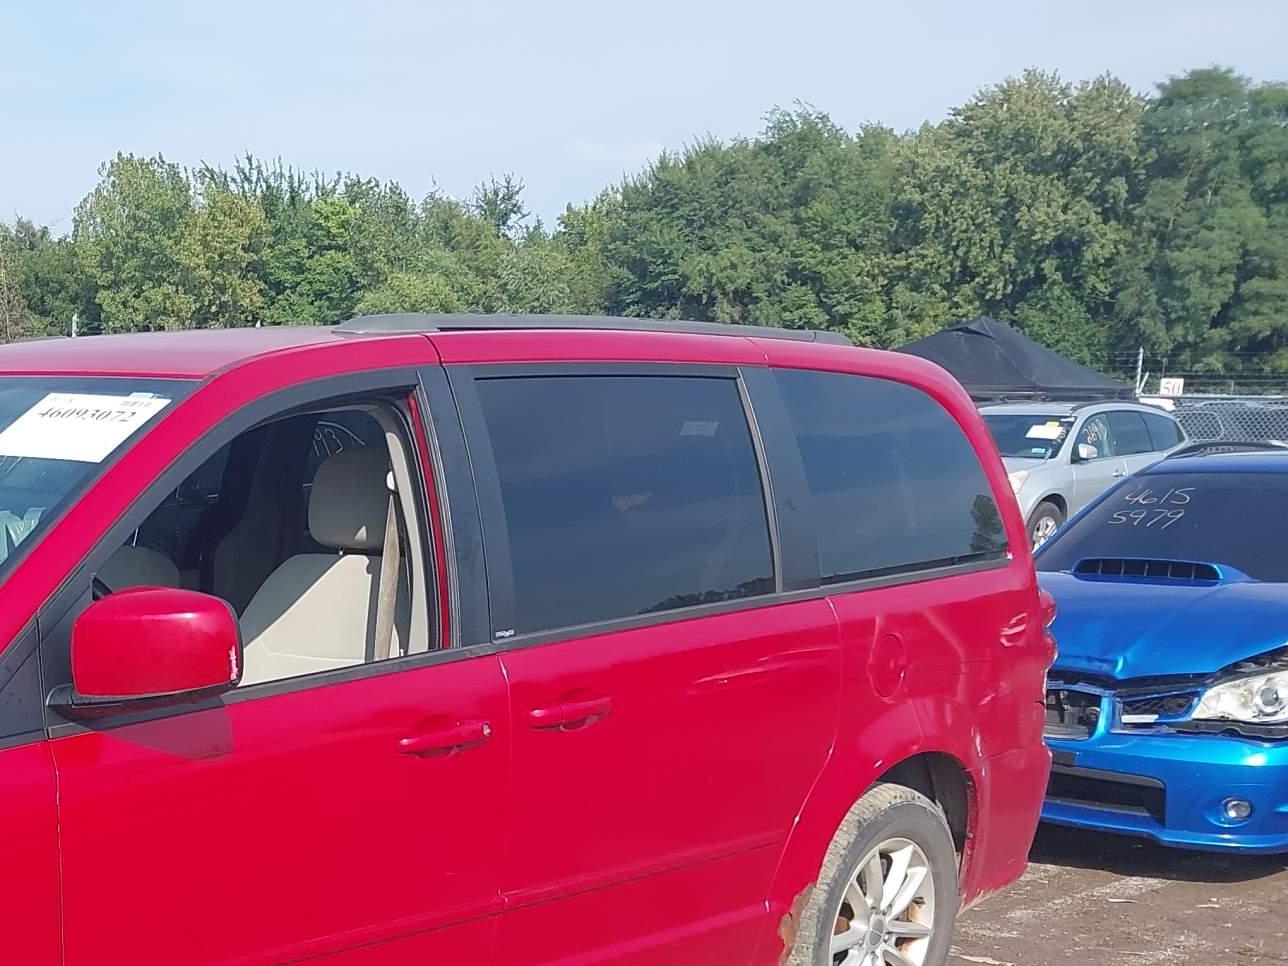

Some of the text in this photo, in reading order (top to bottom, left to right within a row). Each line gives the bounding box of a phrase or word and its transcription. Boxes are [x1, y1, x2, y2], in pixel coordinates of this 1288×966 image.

[38, 407, 137, 423] 46093072
[1125, 487, 1196, 505] 4615
[1107, 508, 1185, 530] 5979
